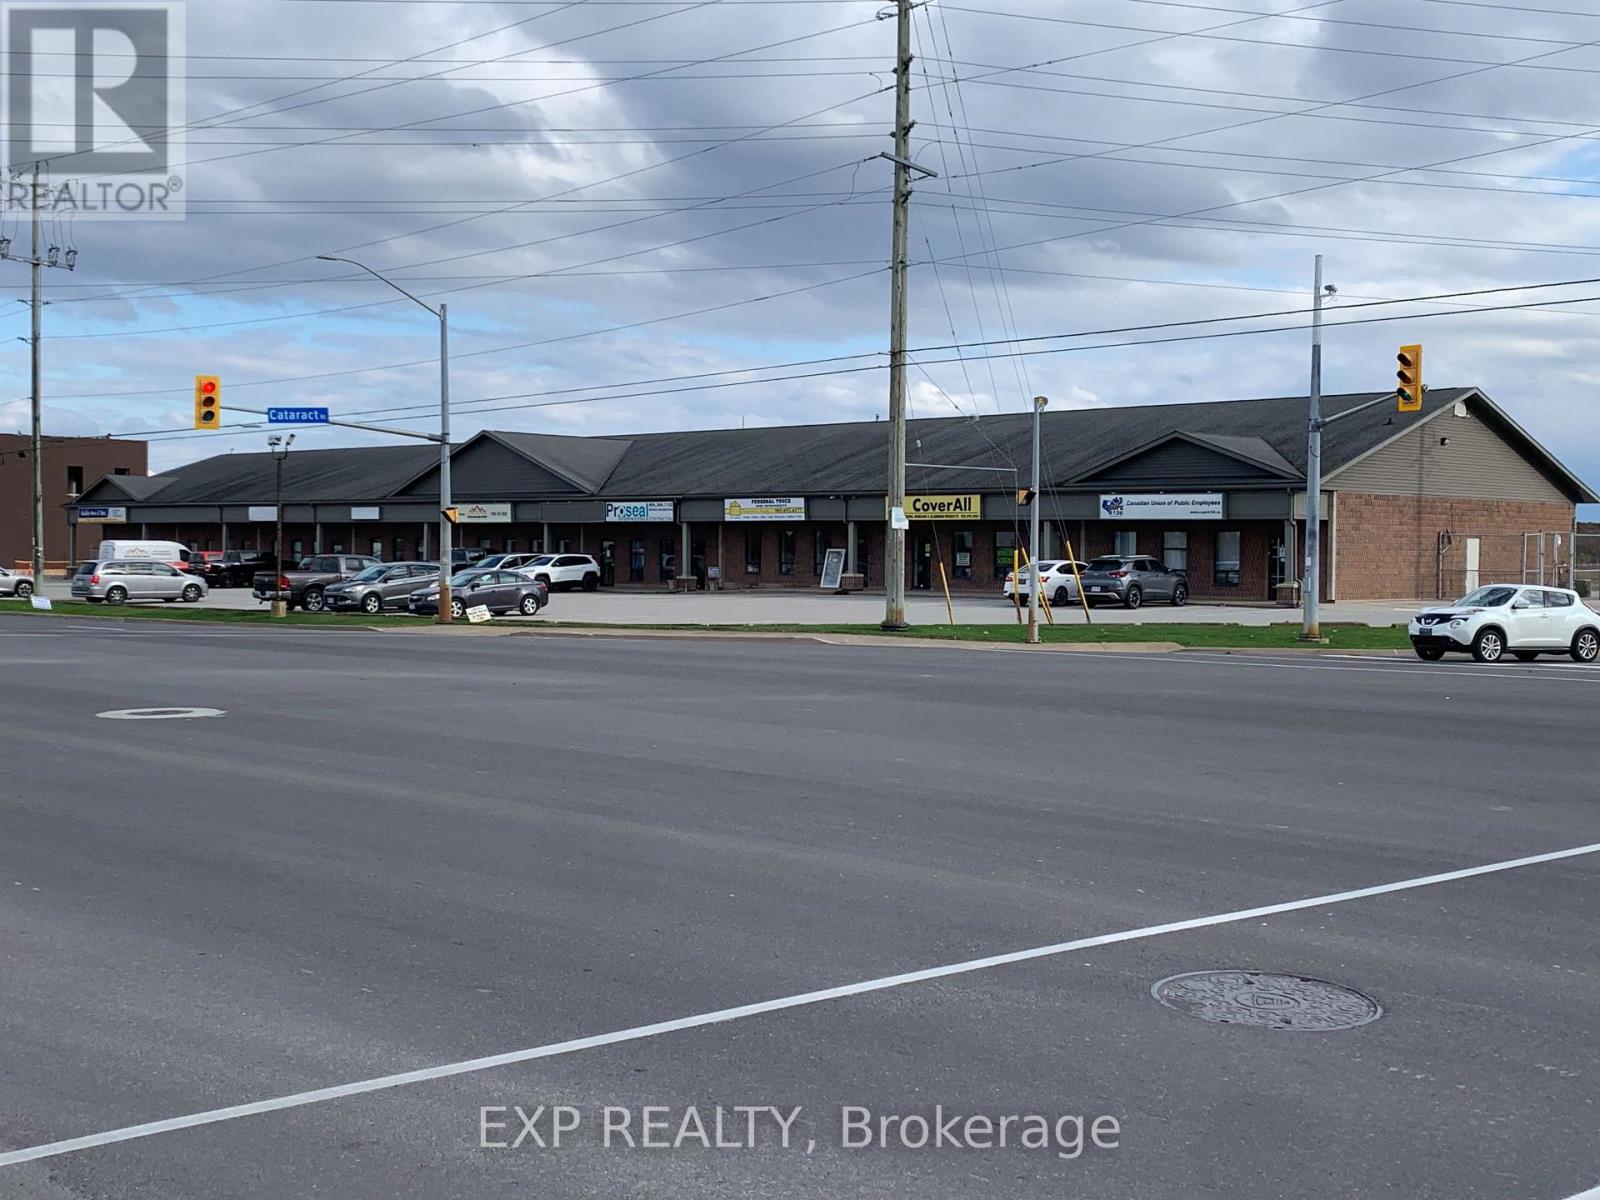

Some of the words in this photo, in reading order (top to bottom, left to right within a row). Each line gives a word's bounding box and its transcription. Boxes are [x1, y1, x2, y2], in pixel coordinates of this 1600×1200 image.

[269, 409, 319, 420] Cataract
[606, 503, 648, 517] Proseal
[912, 496, 972, 512] CoverAll
